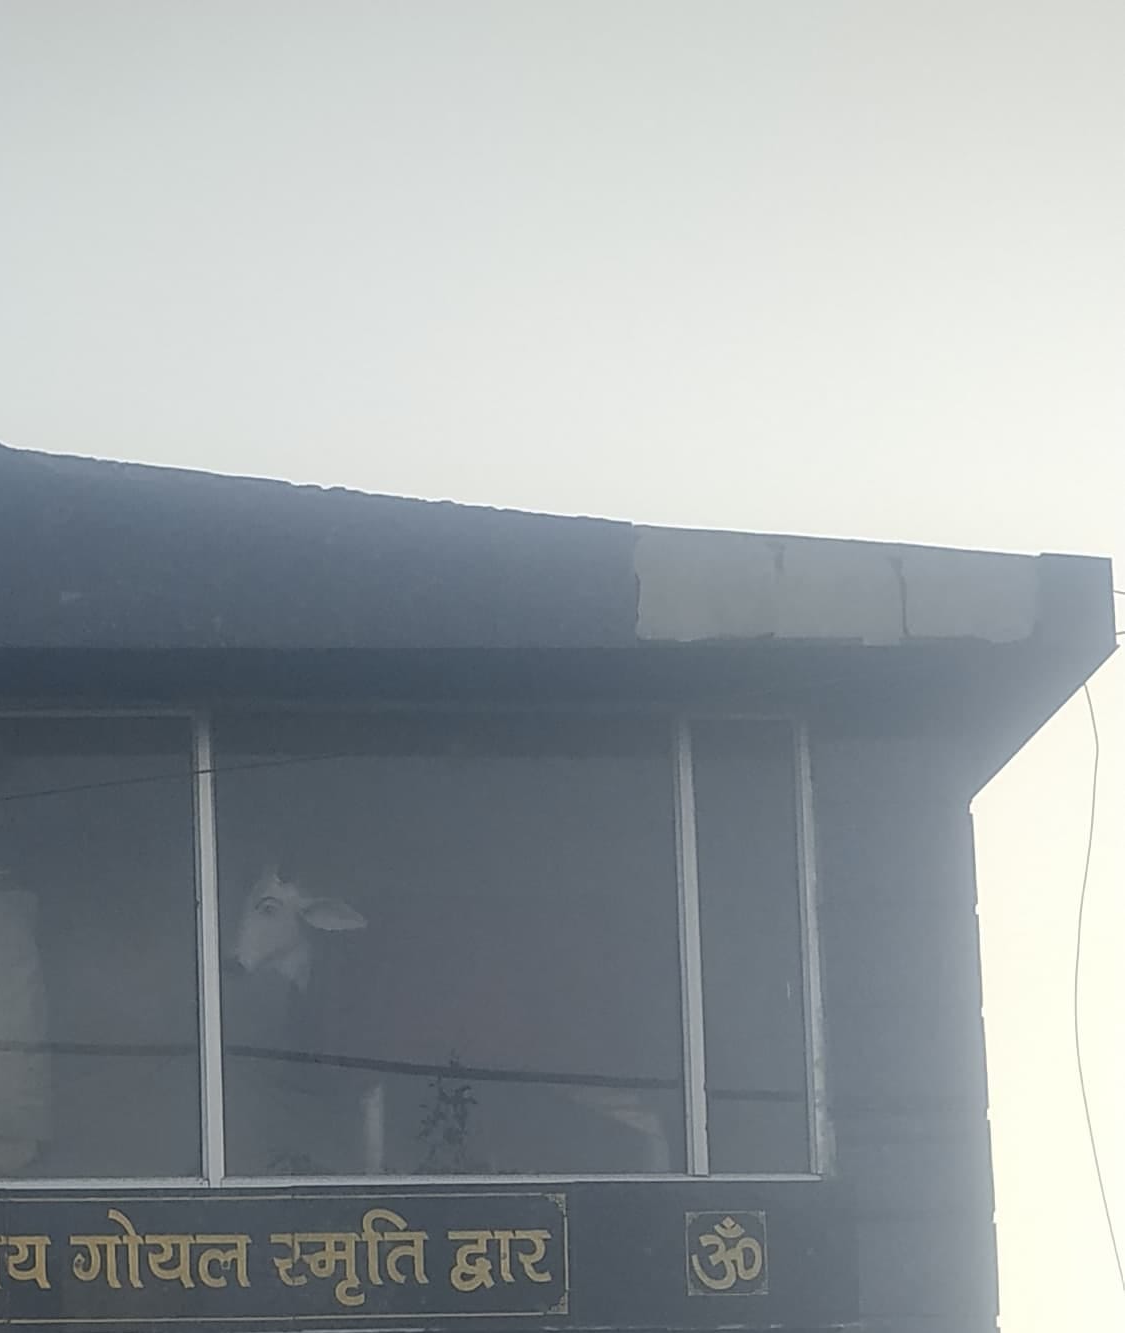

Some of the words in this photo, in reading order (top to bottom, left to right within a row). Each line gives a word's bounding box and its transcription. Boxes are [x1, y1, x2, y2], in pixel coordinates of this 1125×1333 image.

[70, 1210, 250, 1290] गोयल
[270, 1209, 427, 1306] स्मृति
[448, 1229, 552, 1292] द्वार
